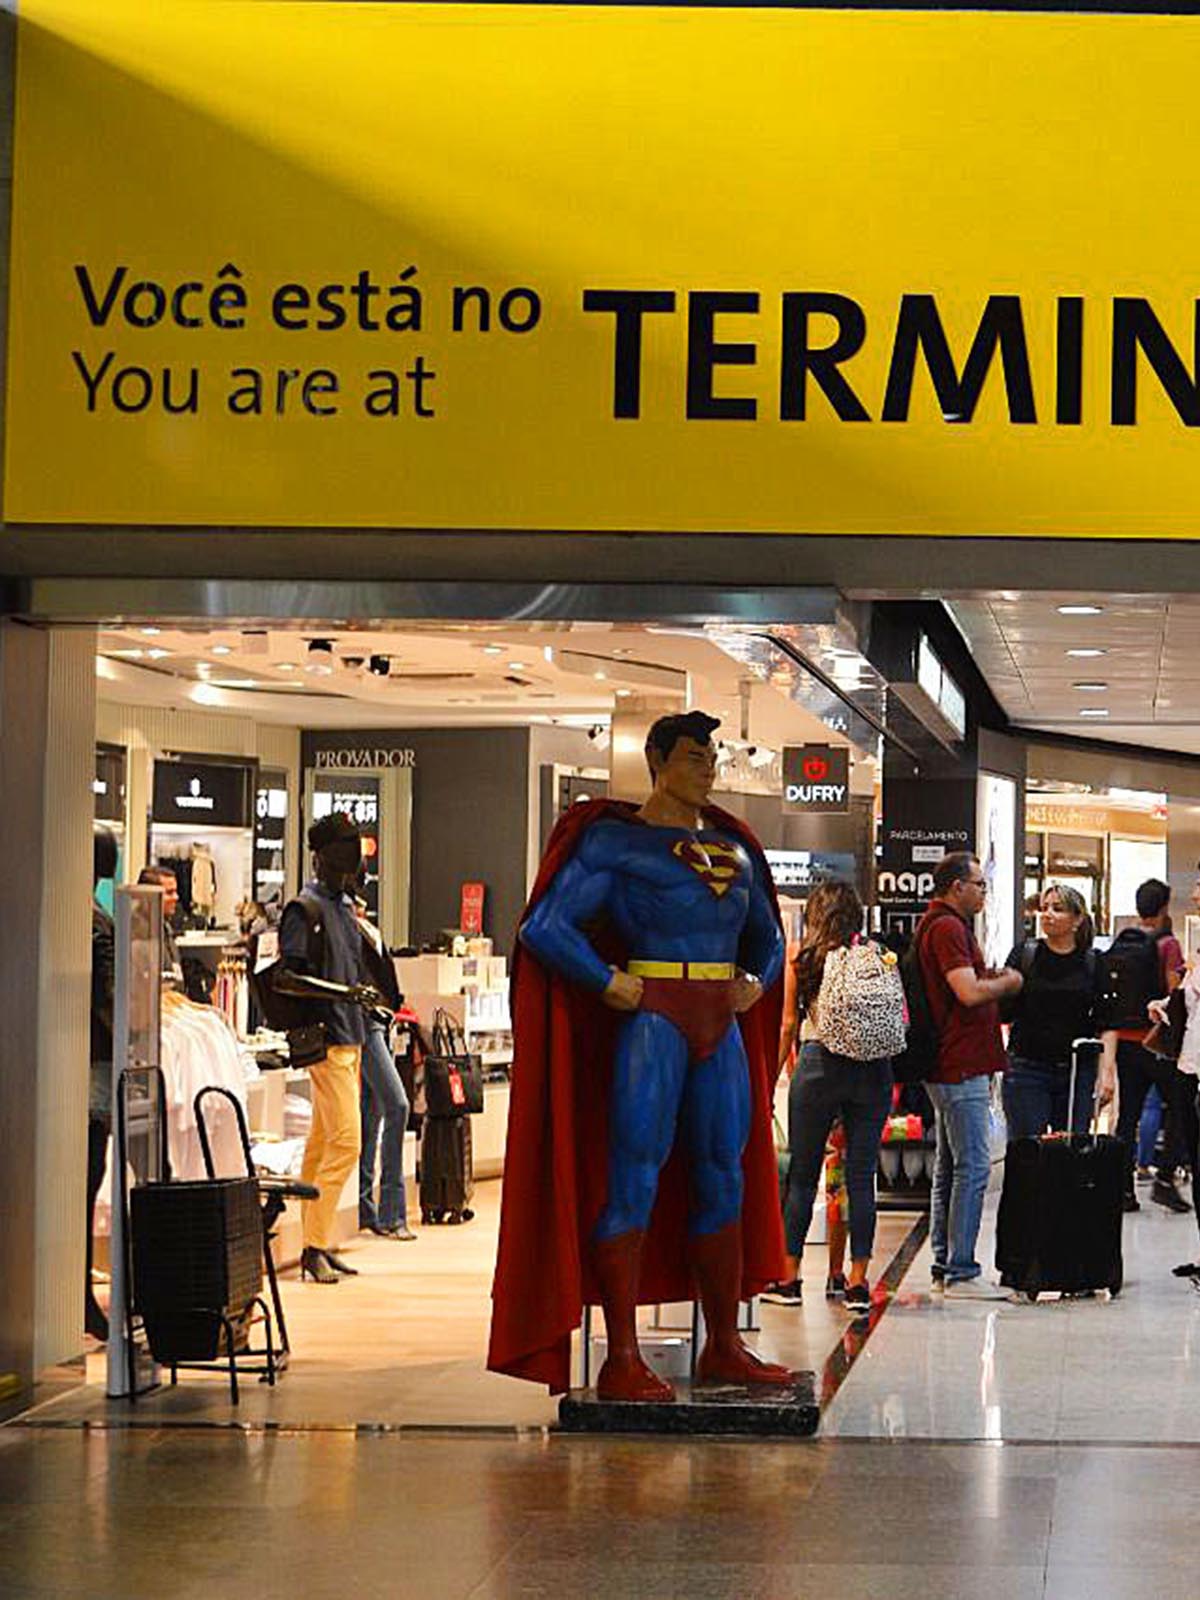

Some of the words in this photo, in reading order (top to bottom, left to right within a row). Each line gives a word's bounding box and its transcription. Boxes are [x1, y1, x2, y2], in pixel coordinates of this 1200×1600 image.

[74, 262, 248, 330] Você
[271, 265, 422, 332] está
[452, 286, 541, 334] no
[72, 351, 199, 414] You
[227, 368, 339, 415] are
[364, 356, 436, 418] at
[315, 749, 417, 768] PROVADOR
[786, 784, 845, 803] DUFRY
[890, 830, 968, 842] PARCELAMENTO
